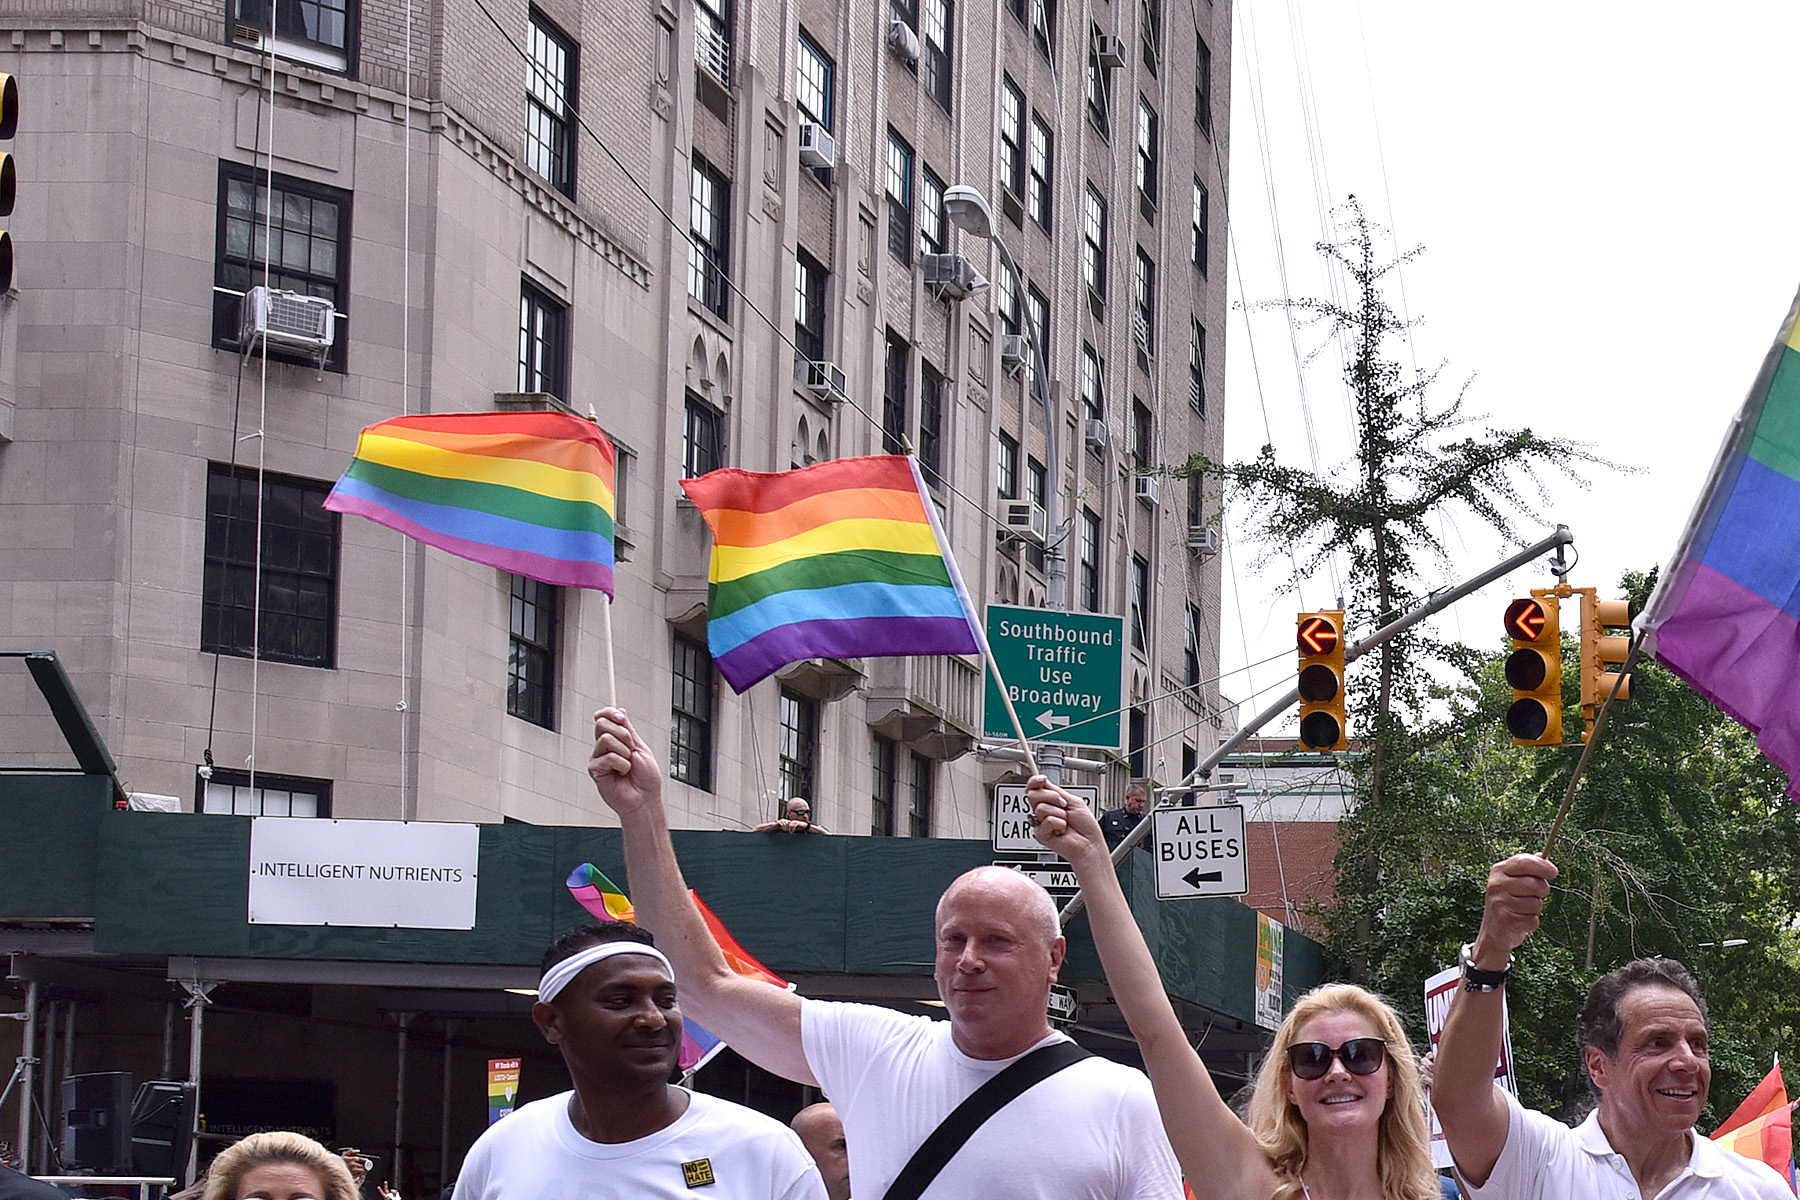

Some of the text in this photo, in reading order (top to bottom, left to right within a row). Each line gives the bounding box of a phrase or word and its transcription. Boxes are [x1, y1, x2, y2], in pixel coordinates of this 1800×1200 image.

[1000, 620, 1113, 646] Southbound
[1027, 644, 1087, 665] Traffic
[1039, 667, 1072, 685] Use
[1009, 685, 1102, 713] Broadway
[1001, 820, 1036, 839] CAR
[1176, 814, 1223, 835] ALL
[1161, 838, 1240, 862] BUSES
[259, 862, 463, 883] INTELLIGENT NUTRIENTS
[1050, 873, 1078, 887] WAY
[1058, 993, 1074, 1011] WAY
[684, 1163, 698, 1174] NO
[687, 1170, 712, 1182] HATE
